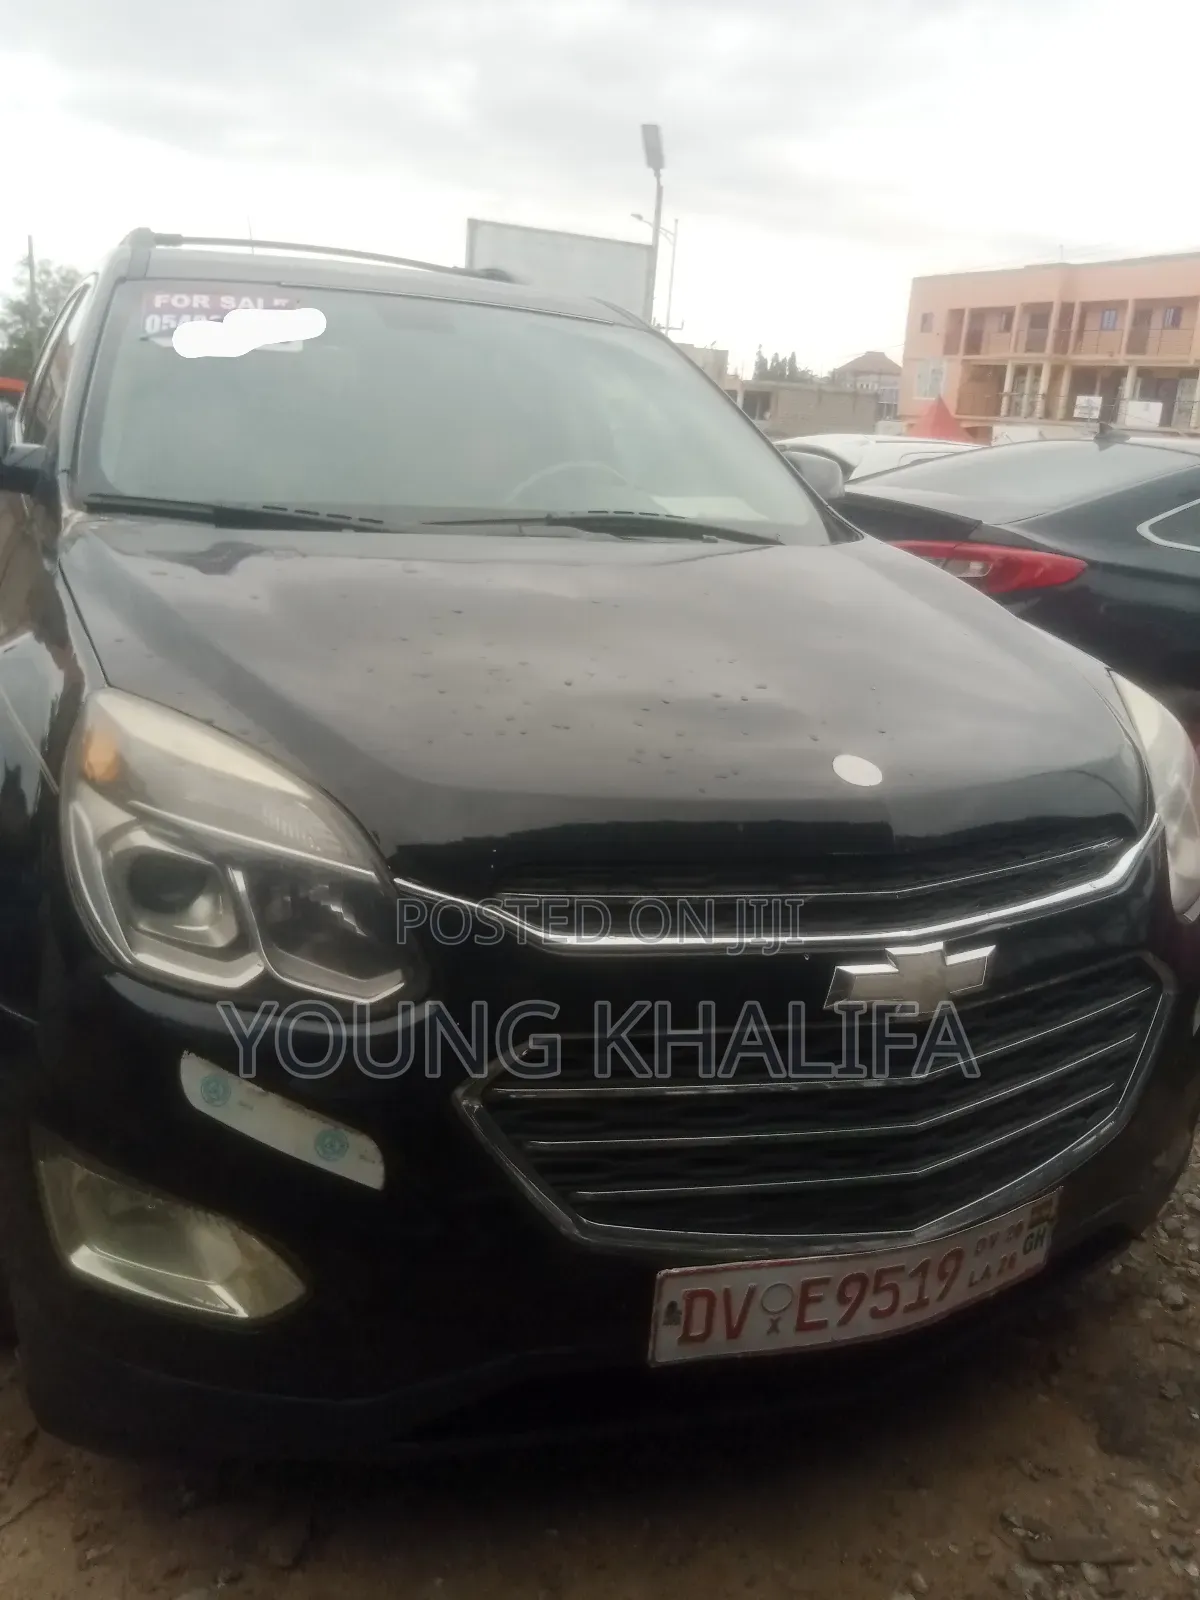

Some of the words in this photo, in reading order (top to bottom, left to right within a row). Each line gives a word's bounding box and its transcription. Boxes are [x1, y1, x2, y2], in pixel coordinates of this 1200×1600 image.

[153, 293, 211, 309] FOR
[1022, 1226, 1046, 1255] GH
[677, 1283, 757, 1345] DV
[795, 1246, 964, 1332] E9519
